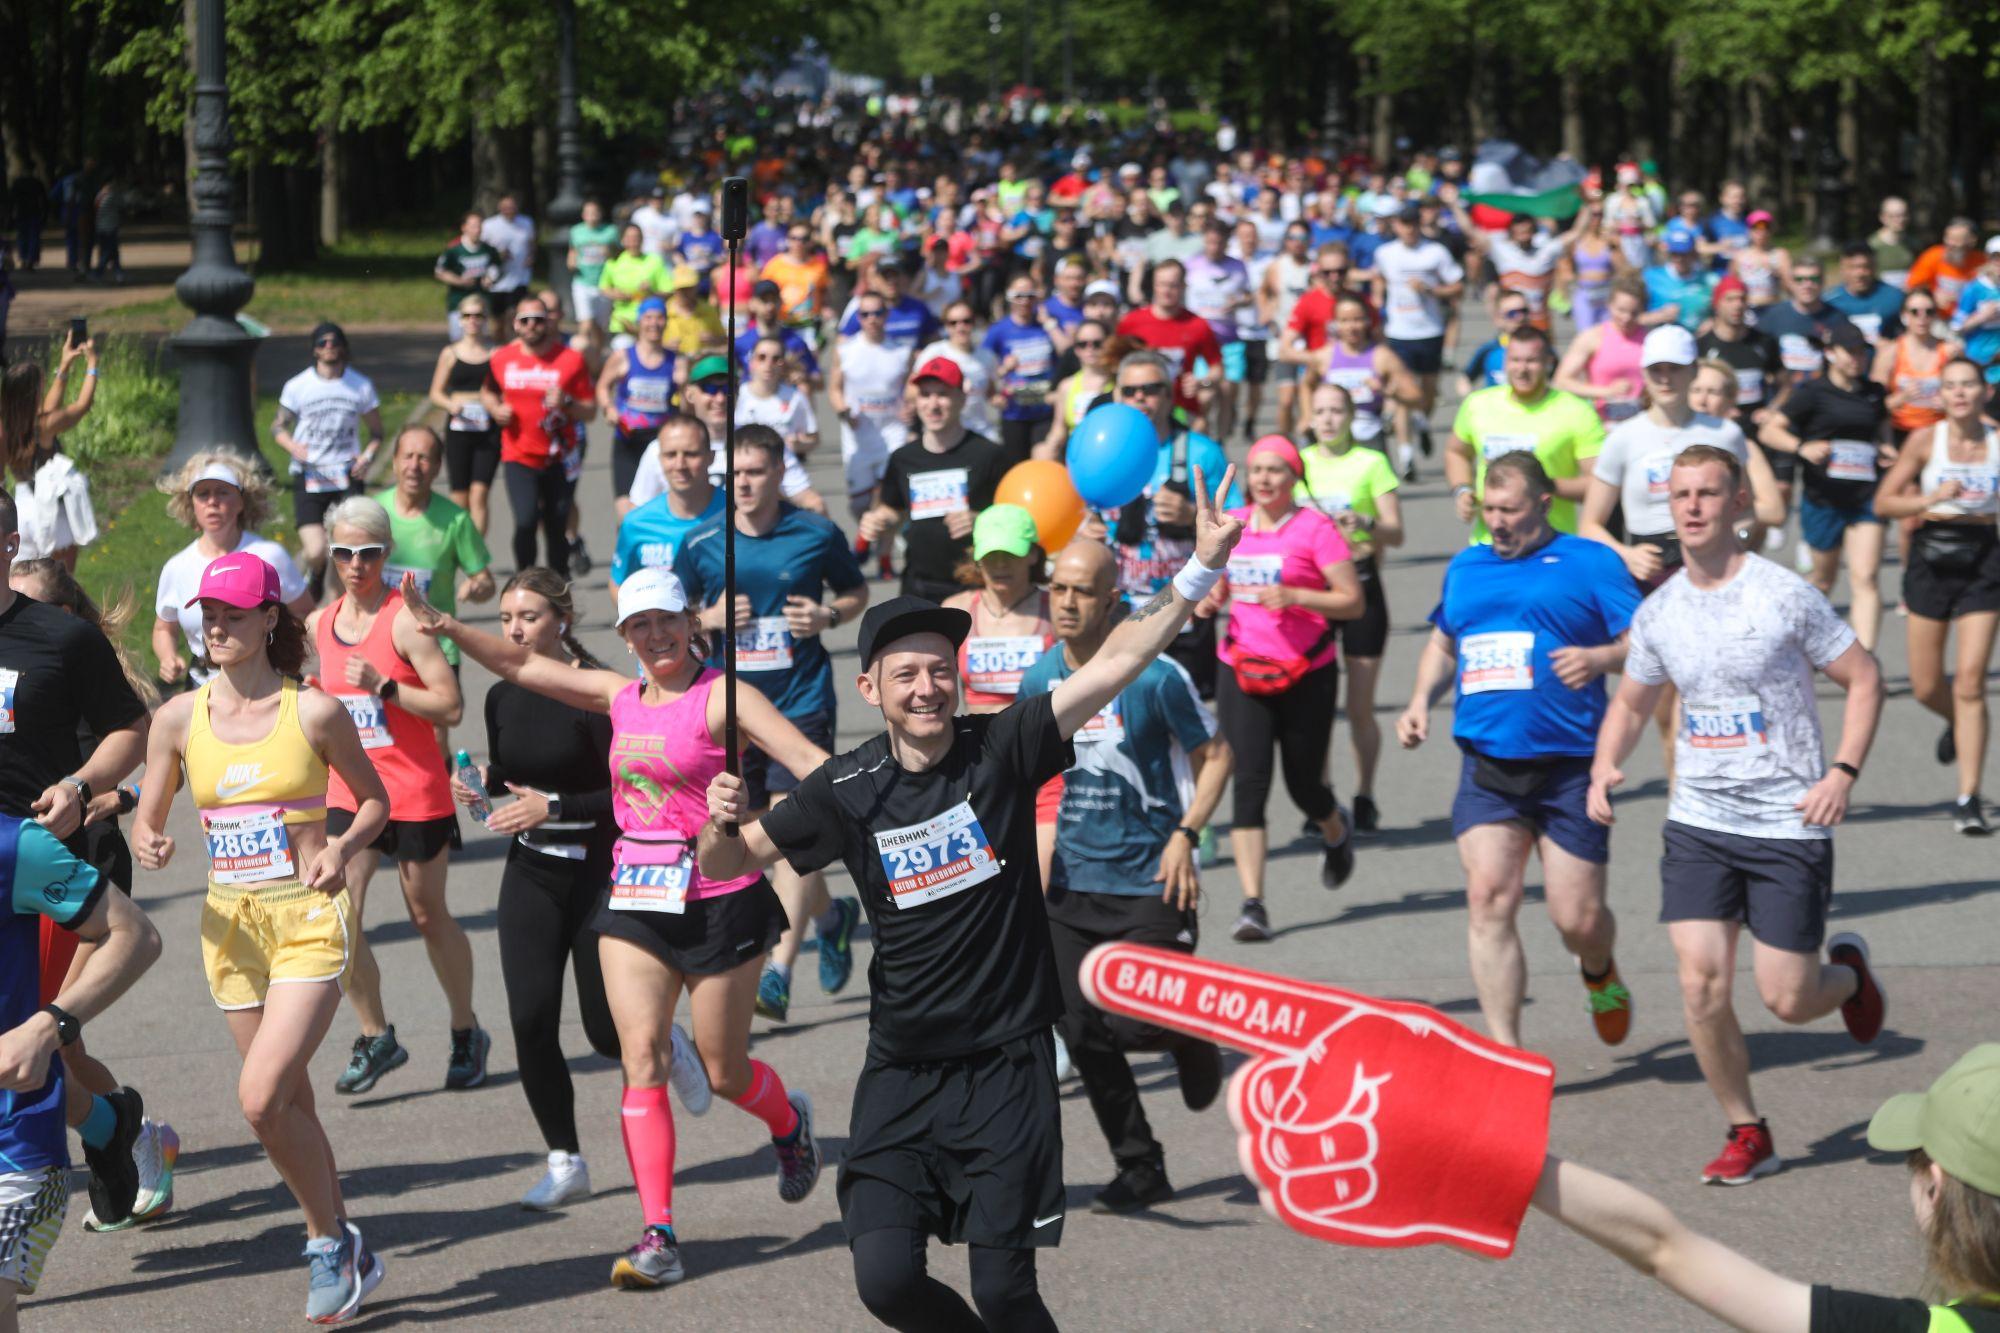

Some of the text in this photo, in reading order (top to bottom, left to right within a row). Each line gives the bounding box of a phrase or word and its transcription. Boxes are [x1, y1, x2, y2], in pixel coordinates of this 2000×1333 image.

[735, 630, 784, 651] 584
[971, 651, 1037, 673] 3094
[354, 709, 378, 728] 07
[1691, 712, 1752, 738] 3081
[221, 763, 263, 785] NIKE
[212, 828, 281, 859] 2864
[880, 828, 930, 848] ДНЕВНИК
[888, 827, 978, 880] 2973
[618, 864, 683, 887] 2779
[894, 878, 918, 893] БЕГОМ
[918, 876, 925, 886] С
[925, 859, 970, 886] ДНЕВНИКОМ
[1115, 961, 1307, 1038] ВАМ СЮДА!
